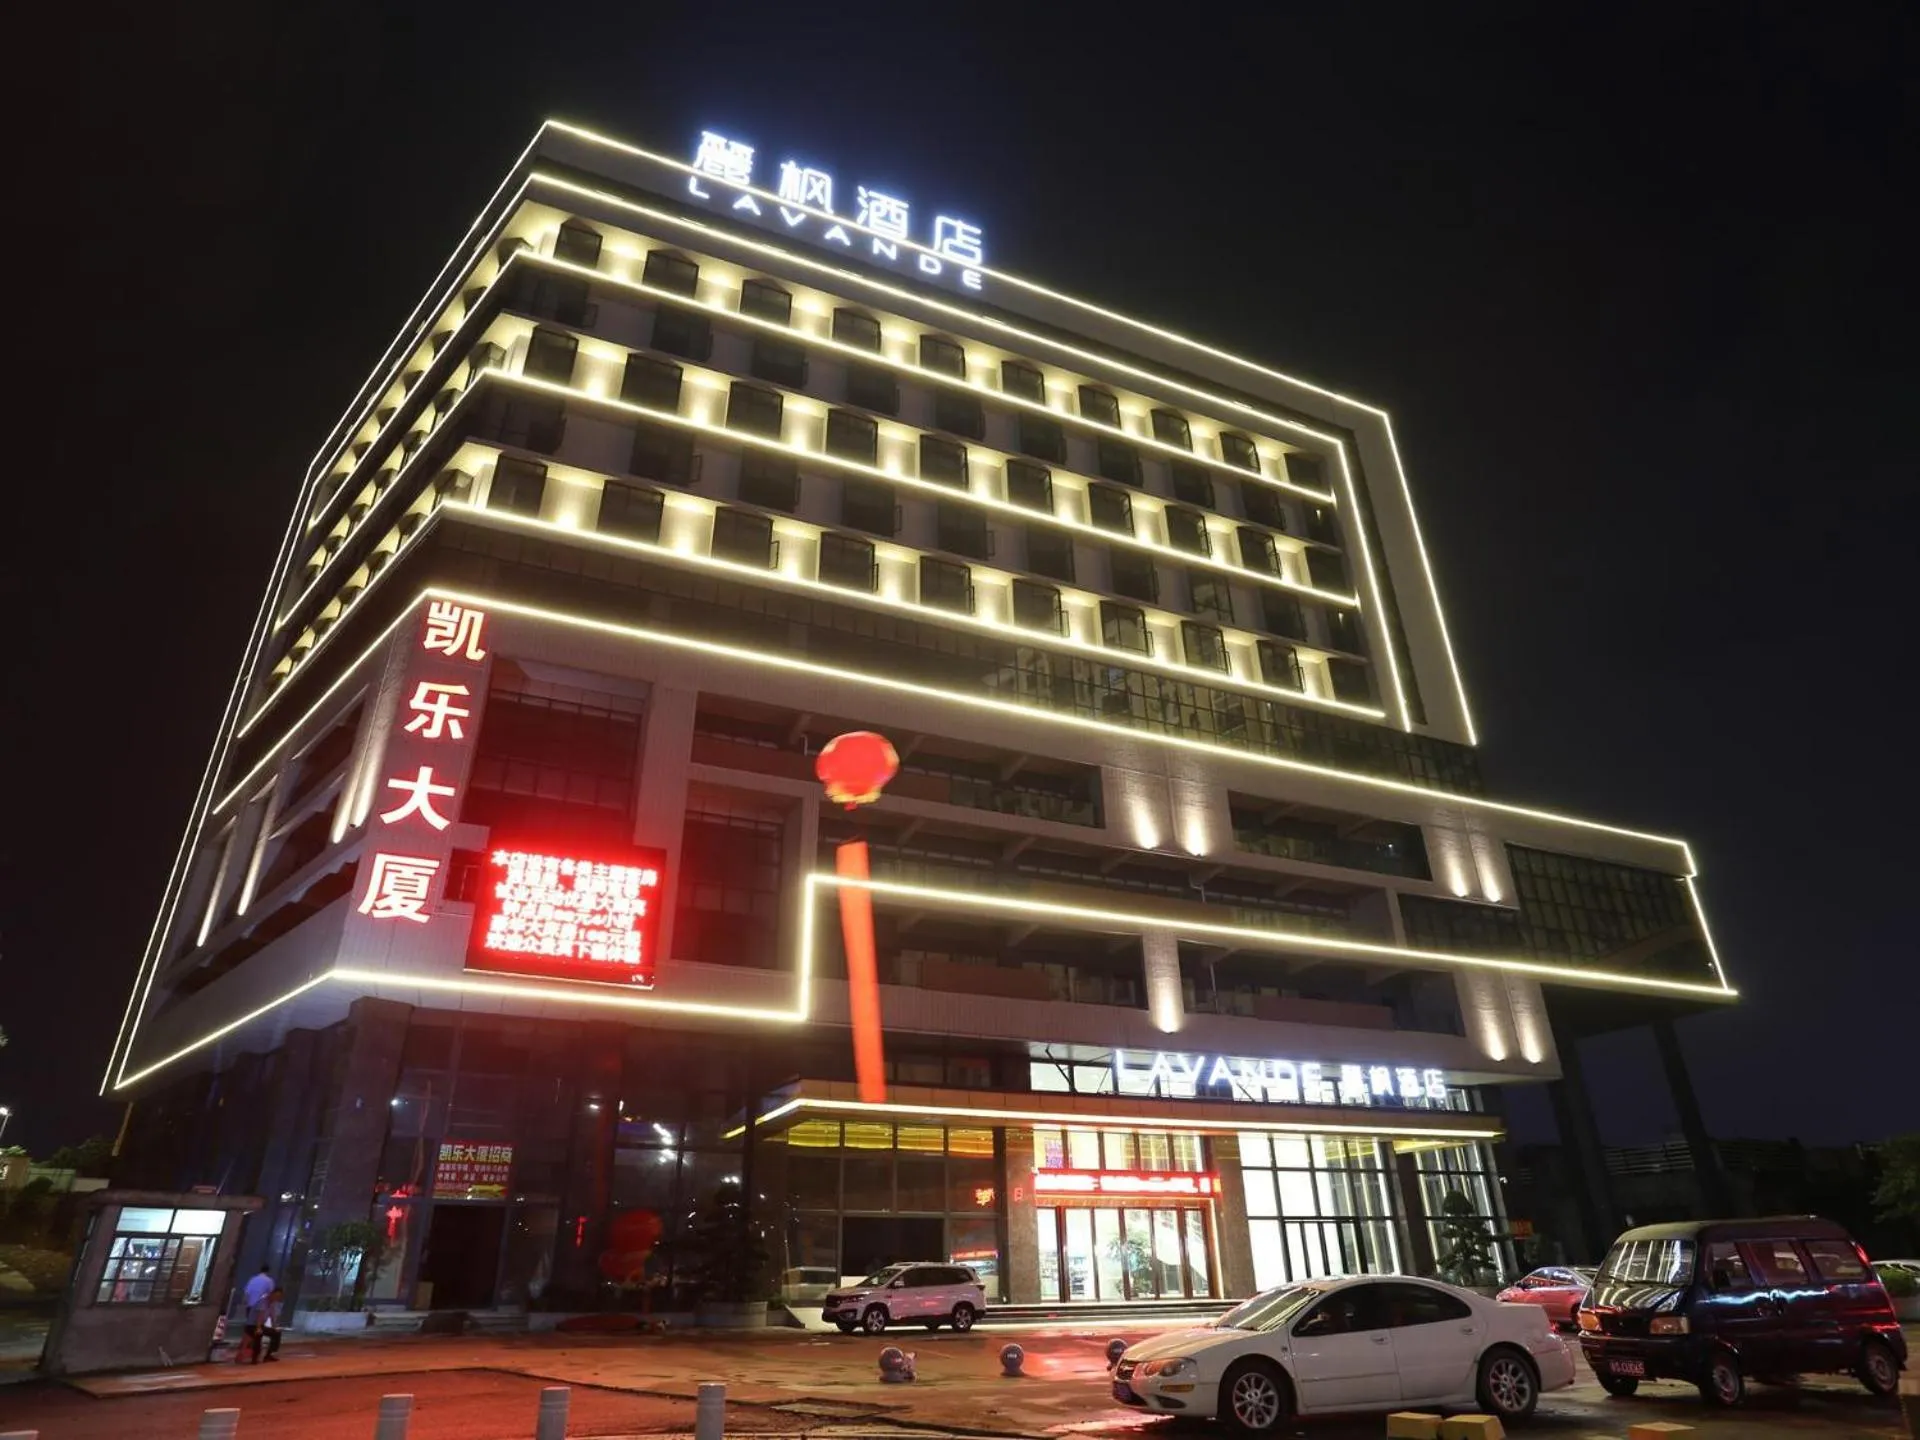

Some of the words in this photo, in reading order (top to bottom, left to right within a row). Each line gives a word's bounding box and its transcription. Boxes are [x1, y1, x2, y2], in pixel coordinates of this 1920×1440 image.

[688, 175, 982, 290] LAVANDE
[357, 600, 487, 924] 凯乐大厦
[1115, 1048, 1322, 1094] LAVANDE
[438, 1143, 513, 1165] 凯乐大厦招商
